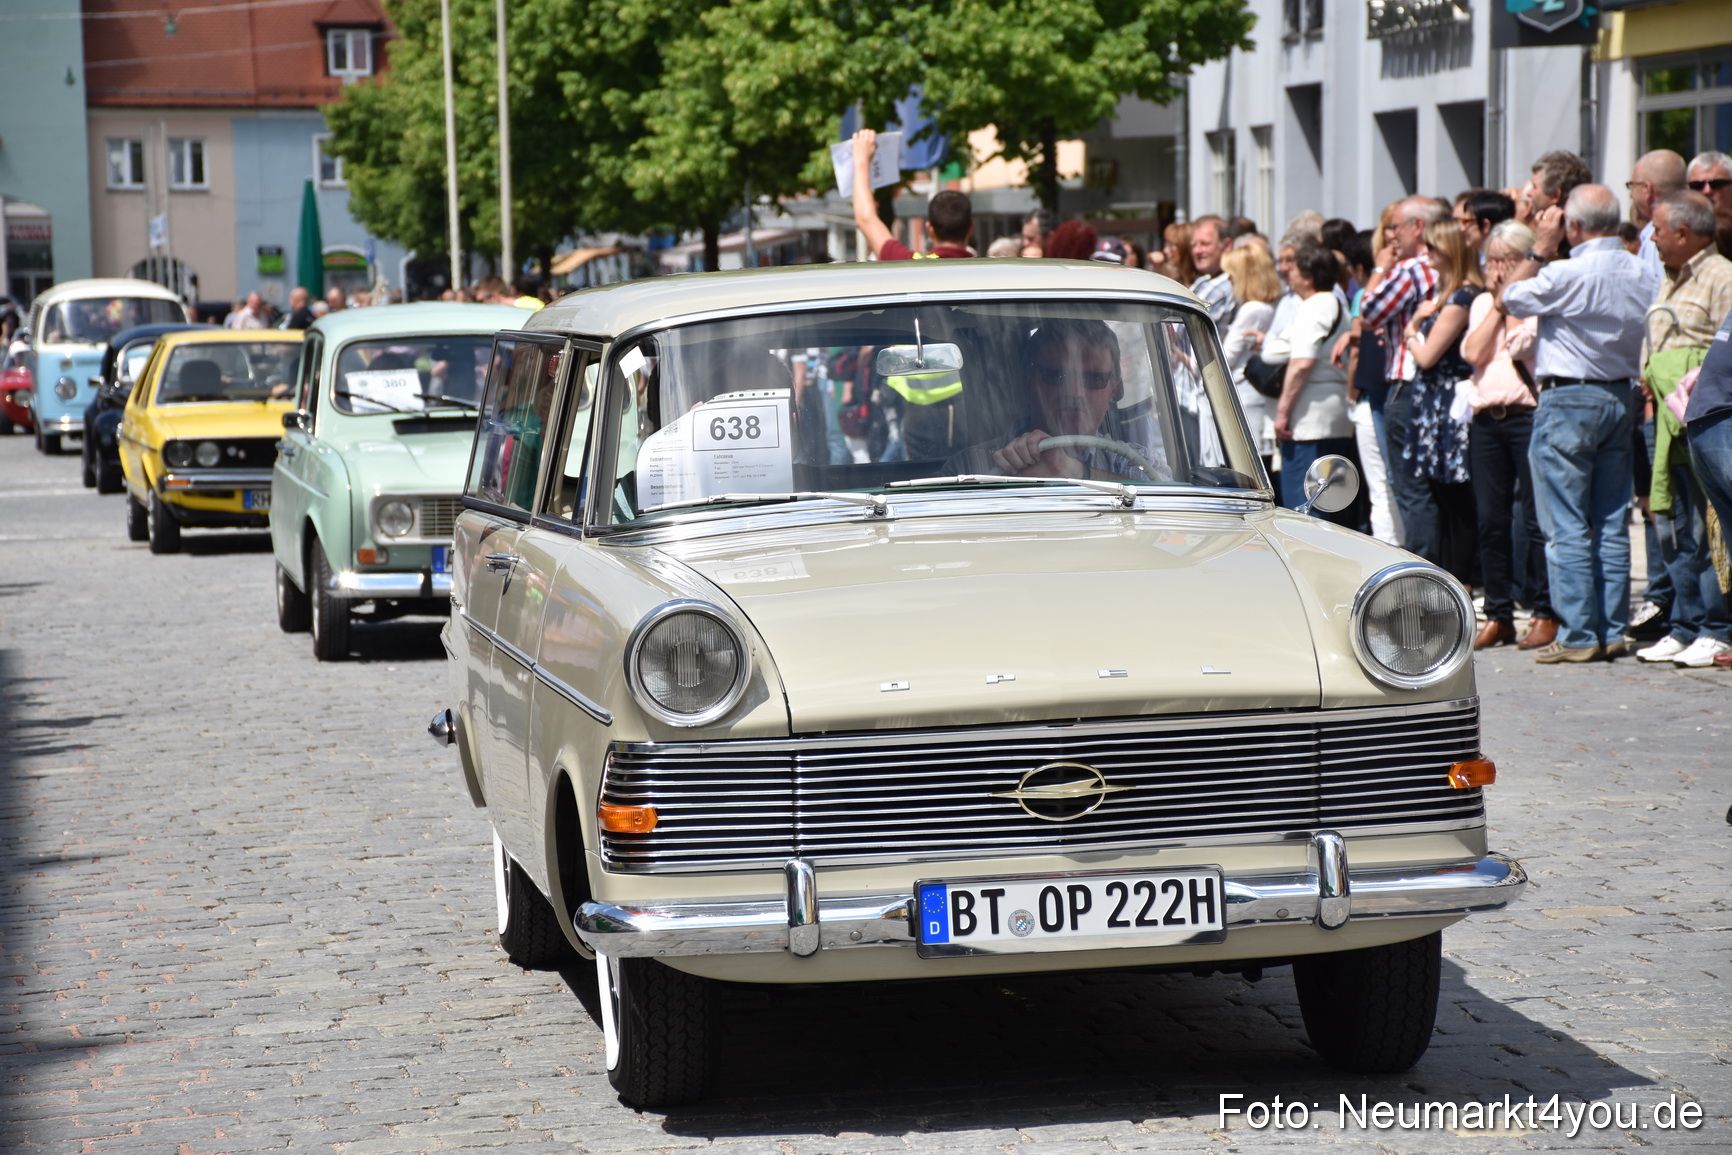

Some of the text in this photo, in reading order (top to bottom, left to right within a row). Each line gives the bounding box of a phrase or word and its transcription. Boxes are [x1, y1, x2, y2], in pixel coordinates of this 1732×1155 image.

[382, 378, 407, 389] 380
[709, 415, 762, 441] 638
[951, 888, 1005, 936] BT
[1038, 884, 1092, 933] OP
[1105, 877, 1216, 929] 222H
[930, 921, 941, 935] D
